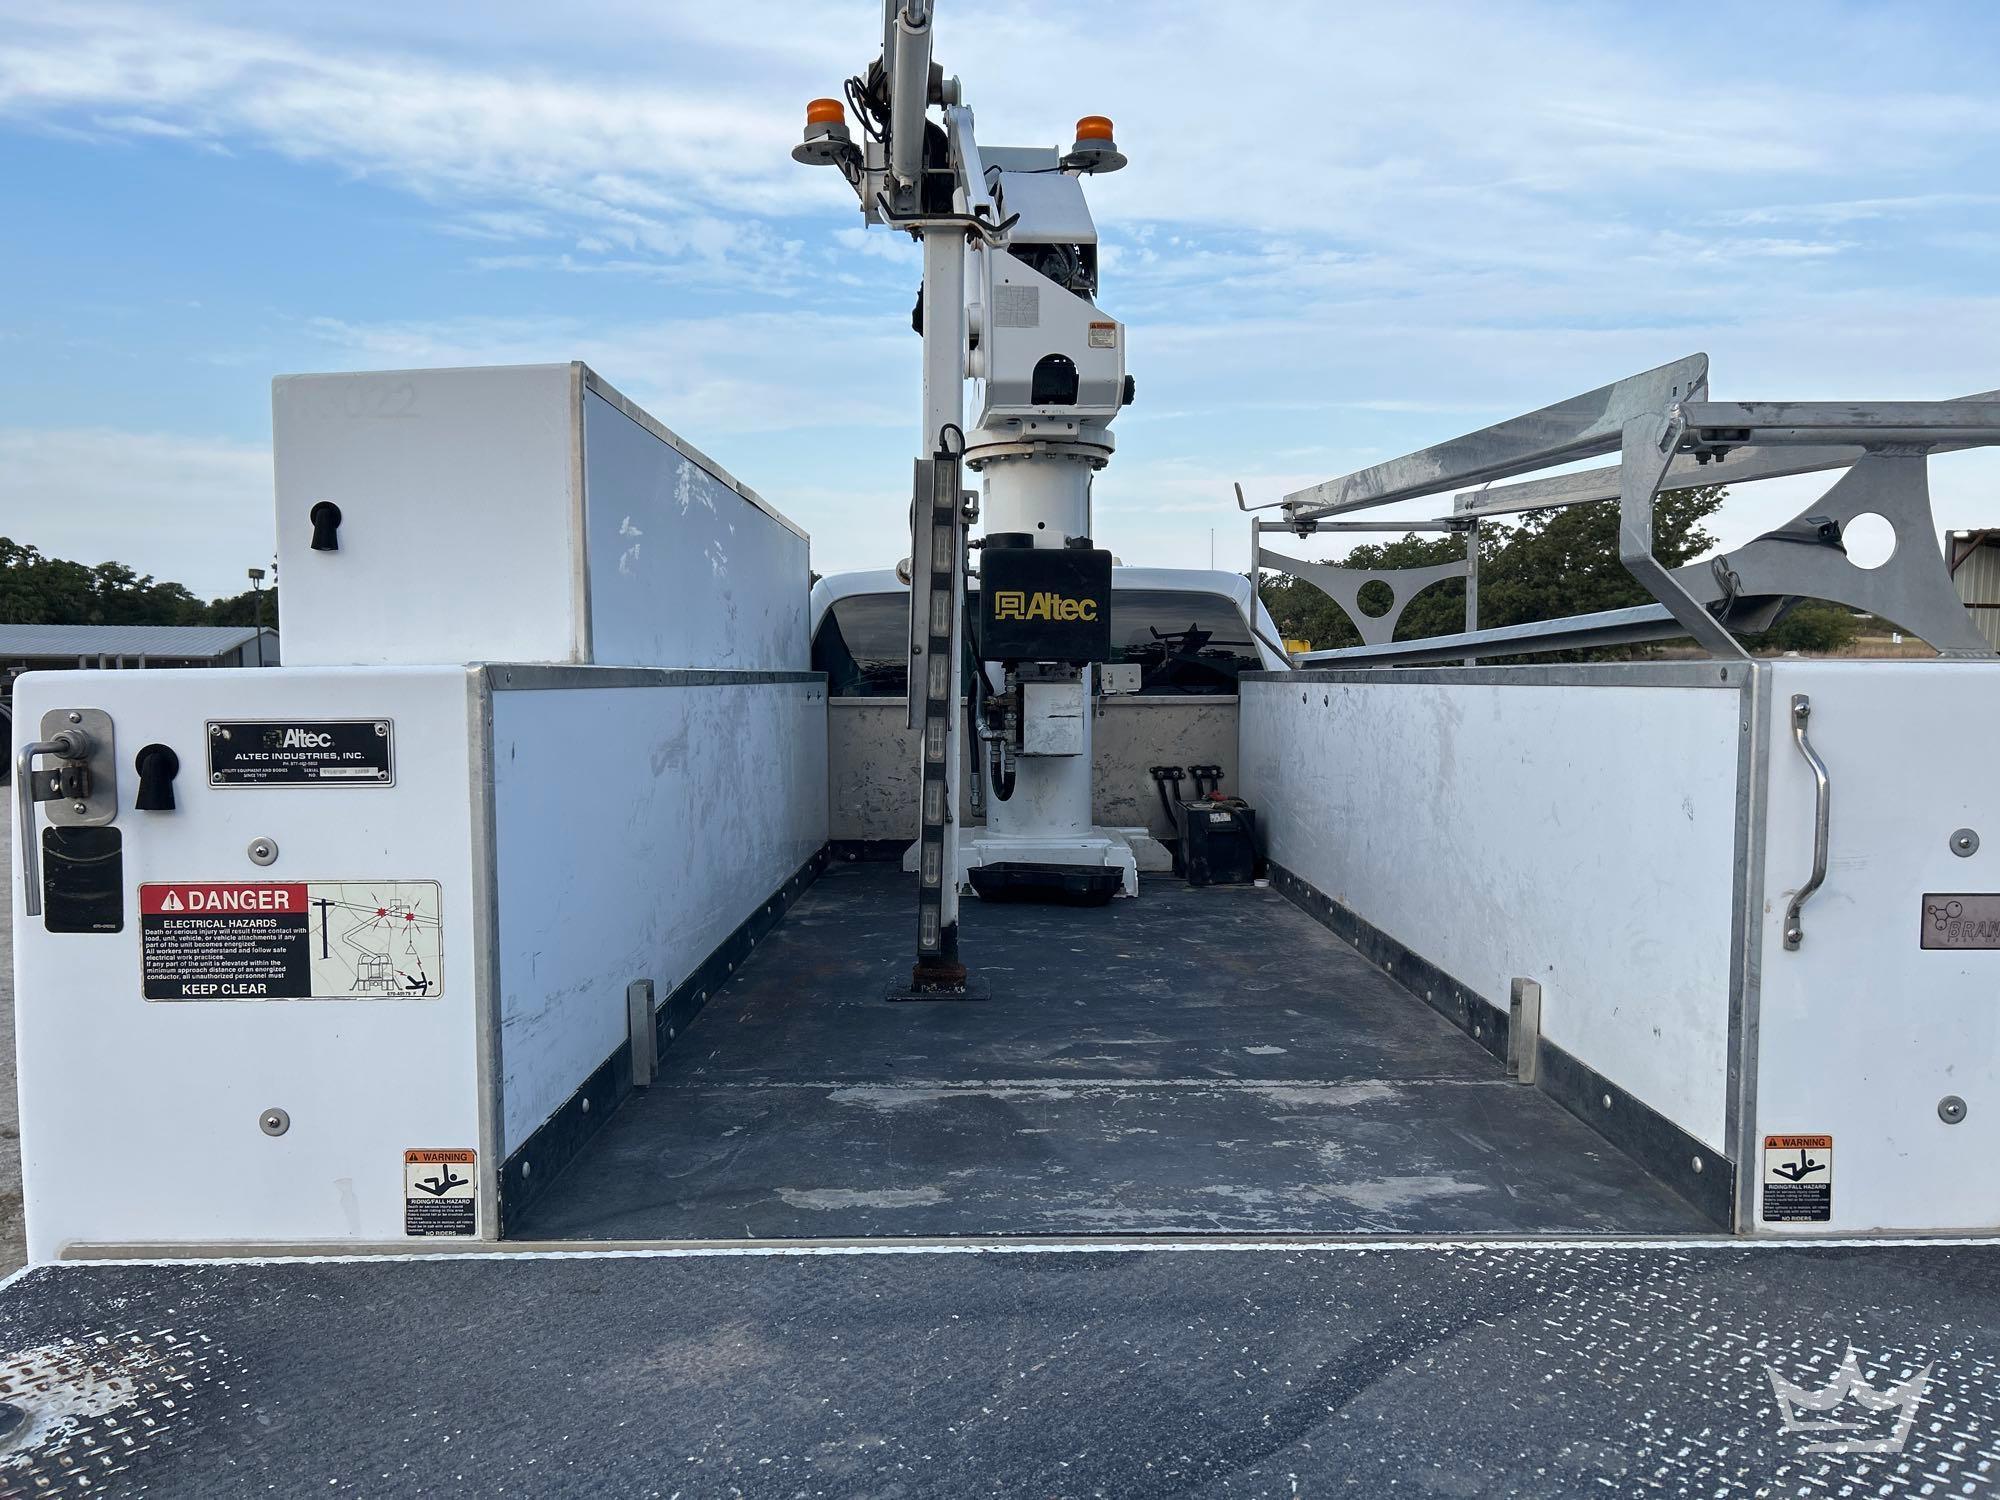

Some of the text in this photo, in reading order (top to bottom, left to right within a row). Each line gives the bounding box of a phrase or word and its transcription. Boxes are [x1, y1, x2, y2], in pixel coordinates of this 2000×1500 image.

[1026, 592, 1097, 621] Altec
[282, 728, 331, 748] Altec
[271, 752, 340, 761] INDUSTRIES,
[188, 890, 290, 910] DANGER
[163, 919, 277, 929] ELECTRICAL HAZARDS
[182, 983, 267, 995] KEEP CLEAR
[1782, 1139, 1825, 1147] WARNING
[423, 1153, 468, 1161] WARNING
